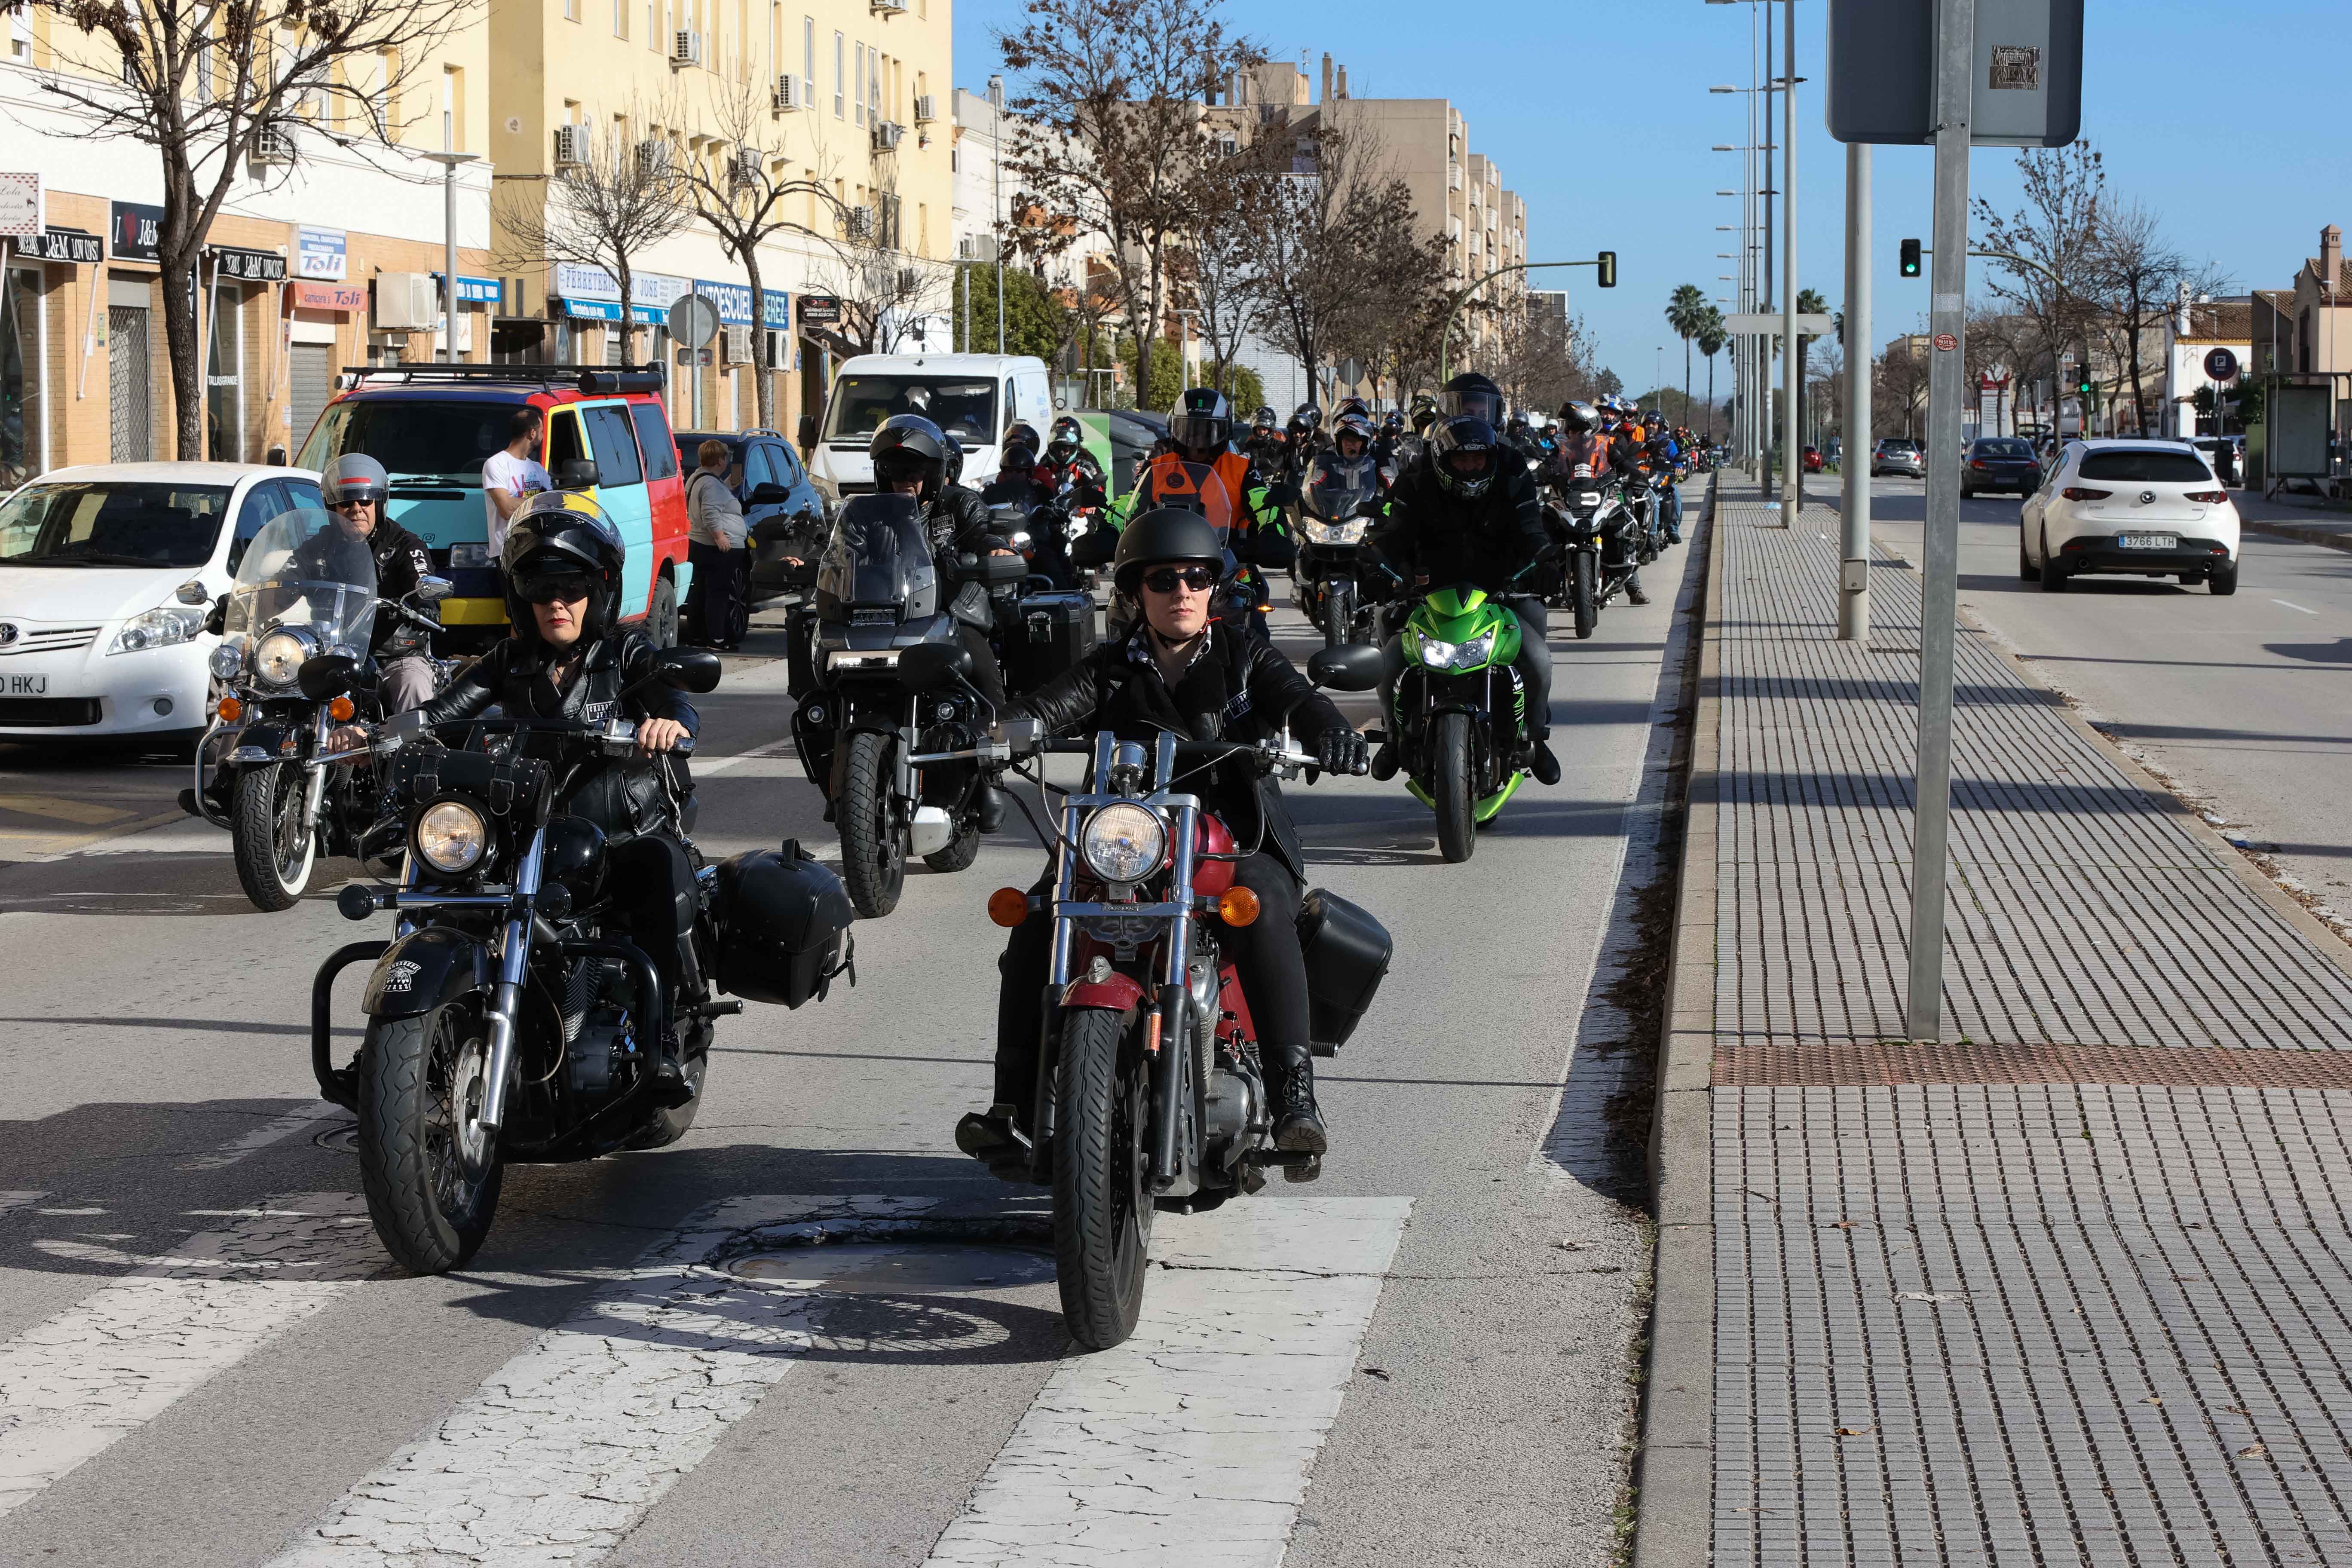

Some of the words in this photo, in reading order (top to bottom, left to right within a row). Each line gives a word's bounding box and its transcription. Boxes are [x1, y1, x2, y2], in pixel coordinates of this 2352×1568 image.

[45, 233, 69, 259] J&M
[303, 254, 343, 272] Toli
[640, 279, 658, 297] JOSE
[334, 291, 361, 305] Toli
[697, 285, 753, 321] TOESCUEL
[2127, 537, 2152, 546] 3766
[2155, 537, 2174, 546] LTH
[12, 677, 45, 693] HKJ
[388, 962, 419, 970] CHEROKEE
